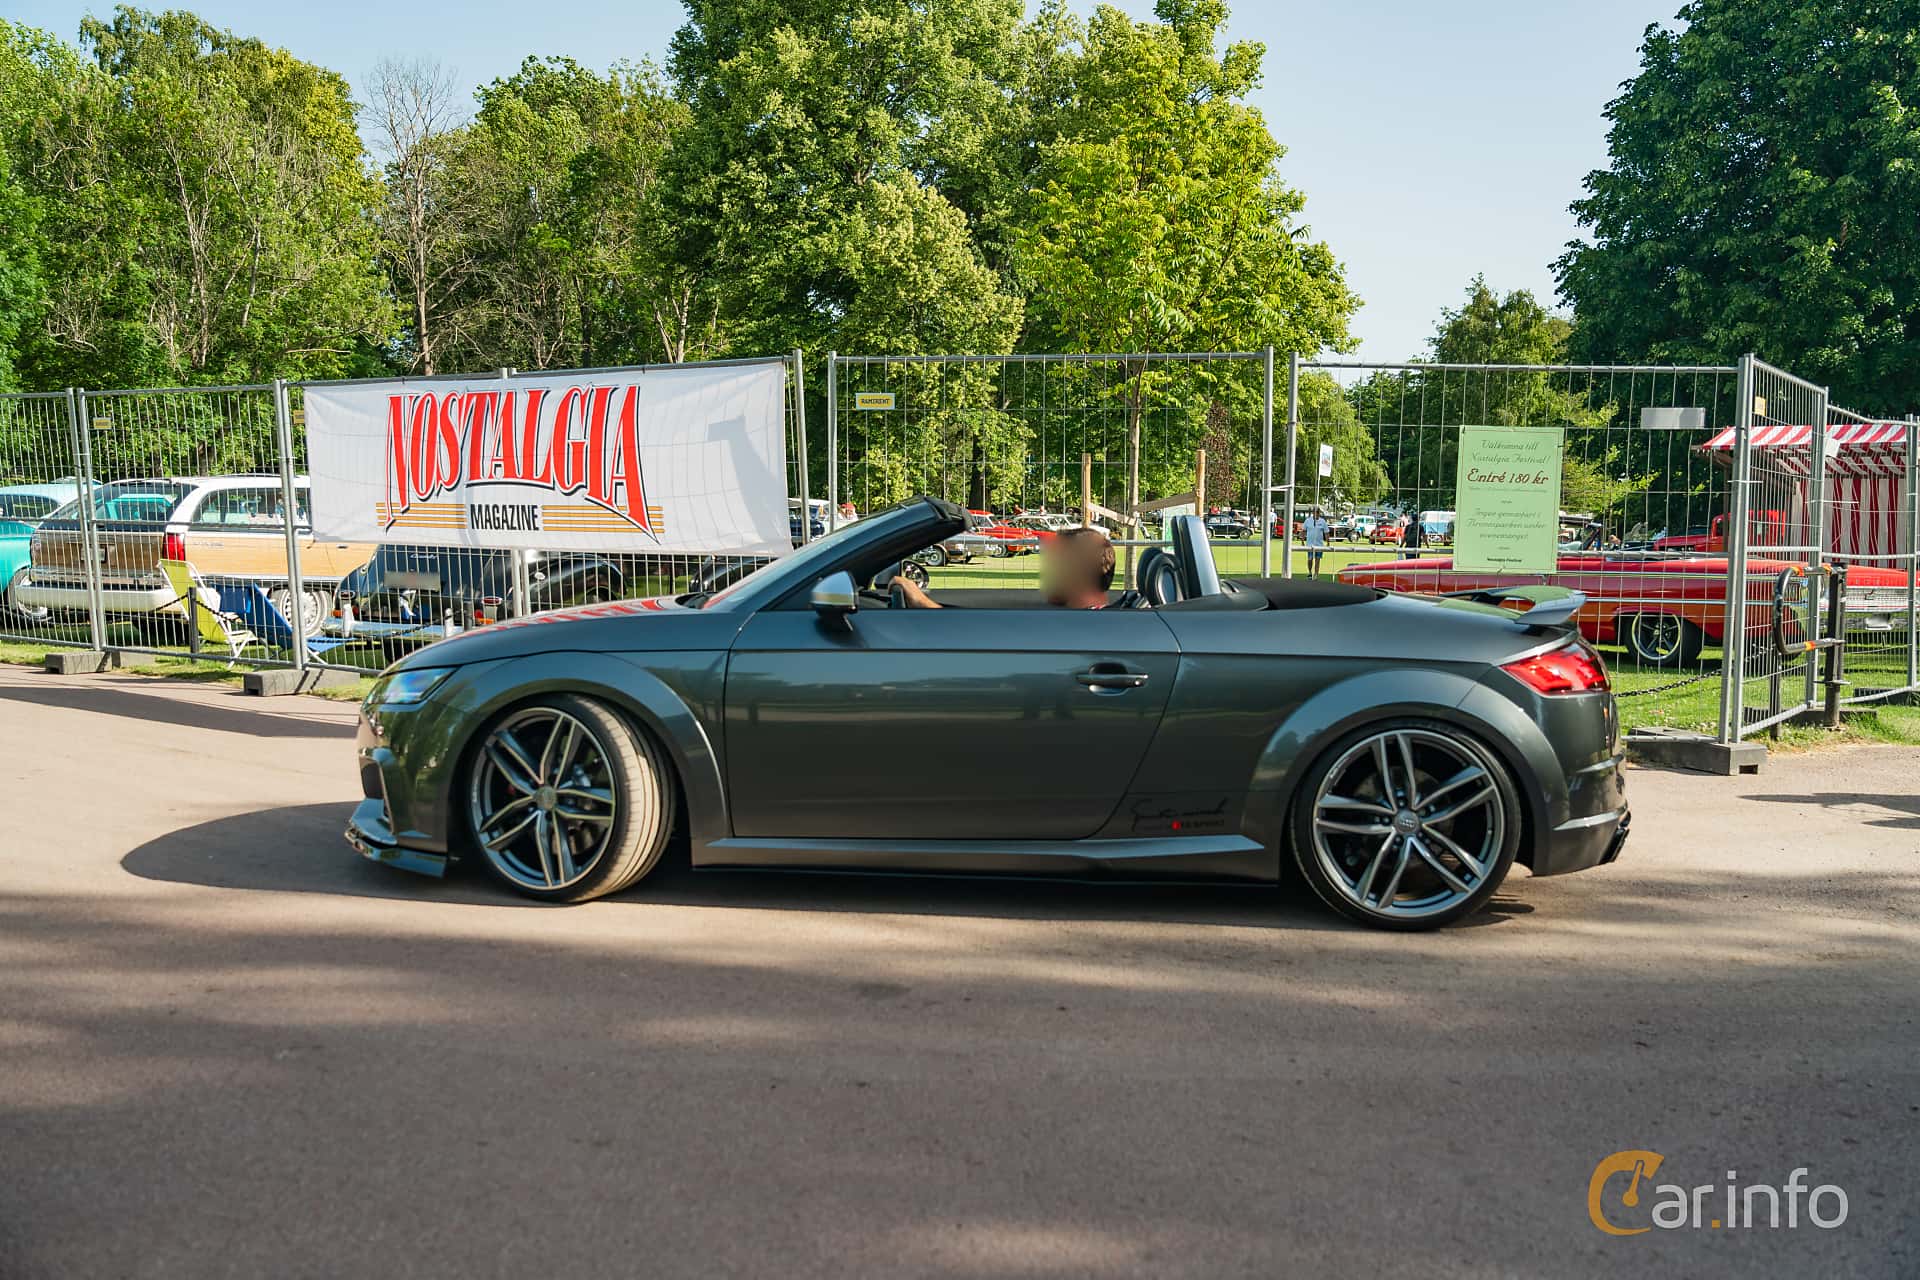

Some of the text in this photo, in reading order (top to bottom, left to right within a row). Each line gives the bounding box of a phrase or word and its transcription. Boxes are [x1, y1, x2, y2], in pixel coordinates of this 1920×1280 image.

[386, 385, 658, 540] NOSTALGIA
[1467, 467, 1549, 484] Entré 180 kr
[470, 503, 540, 531] MAGAZINE
